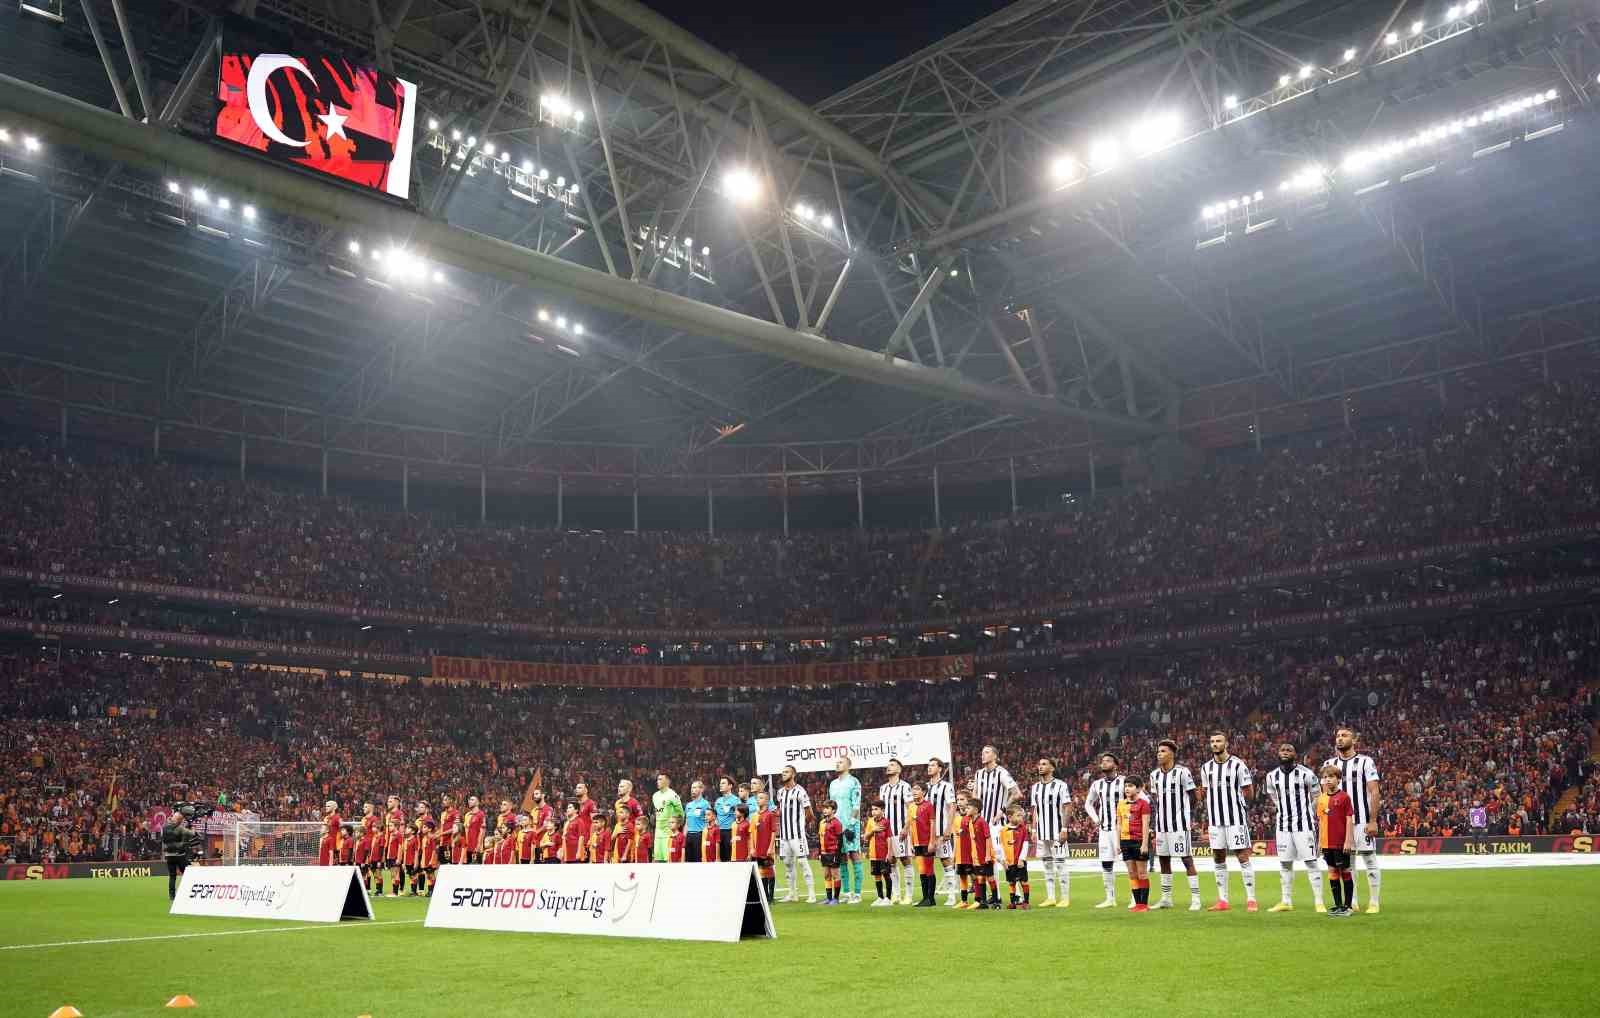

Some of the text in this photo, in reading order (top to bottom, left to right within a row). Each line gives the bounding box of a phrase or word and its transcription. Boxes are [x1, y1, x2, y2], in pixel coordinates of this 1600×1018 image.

[1071, 848, 1097, 857] TAKIM
[1174, 842, 1184, 853] 83
[90, 868, 113, 880] TEK
[115, 866, 151, 879] TAKIM
